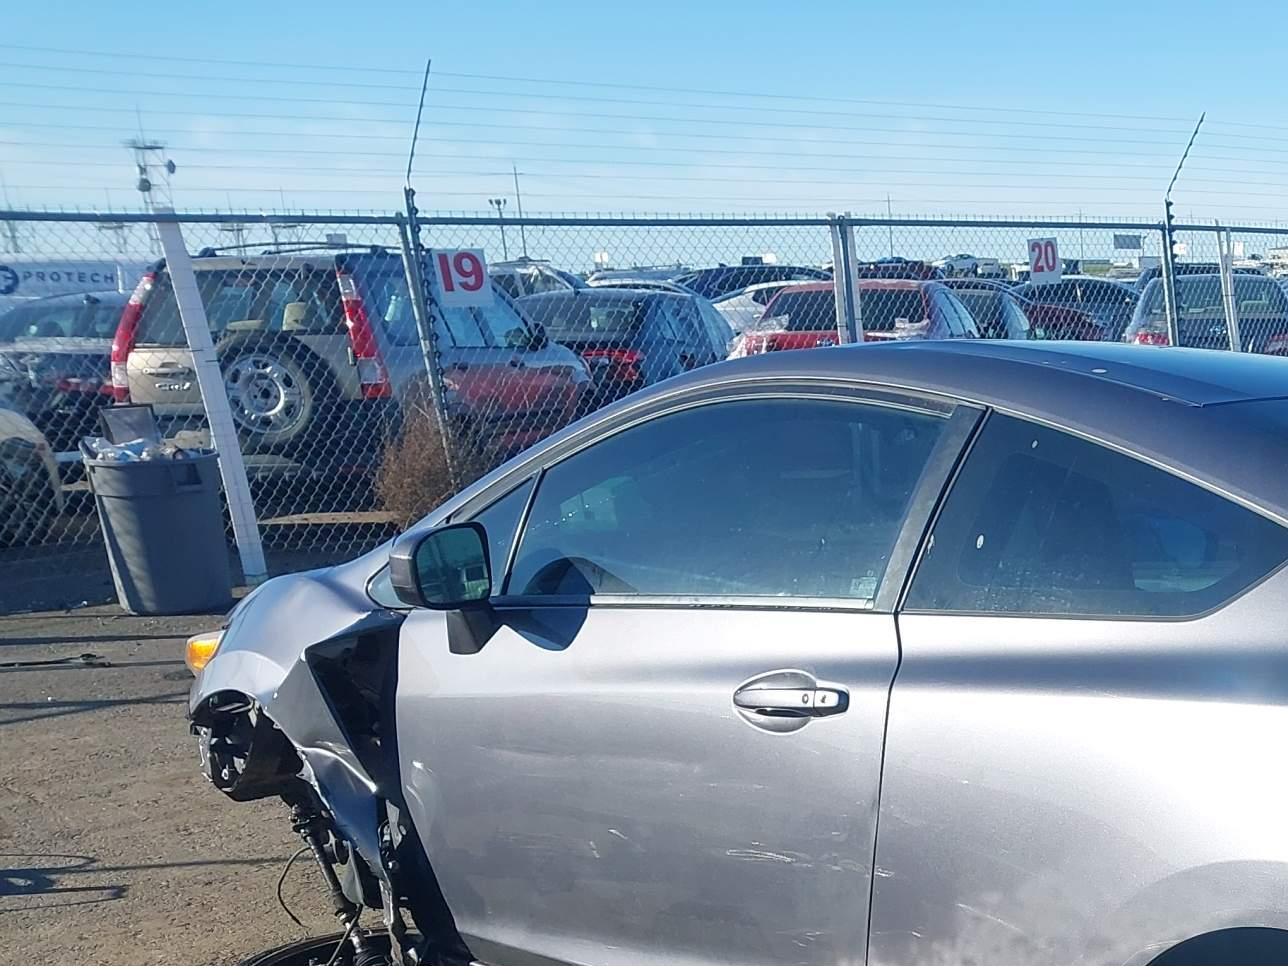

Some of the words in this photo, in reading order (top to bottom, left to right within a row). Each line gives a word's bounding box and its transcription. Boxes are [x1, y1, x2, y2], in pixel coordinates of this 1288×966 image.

[437, 252, 484, 292] 19
[1031, 241, 1056, 272] 20
[22, 271, 115, 284] PROTECH
